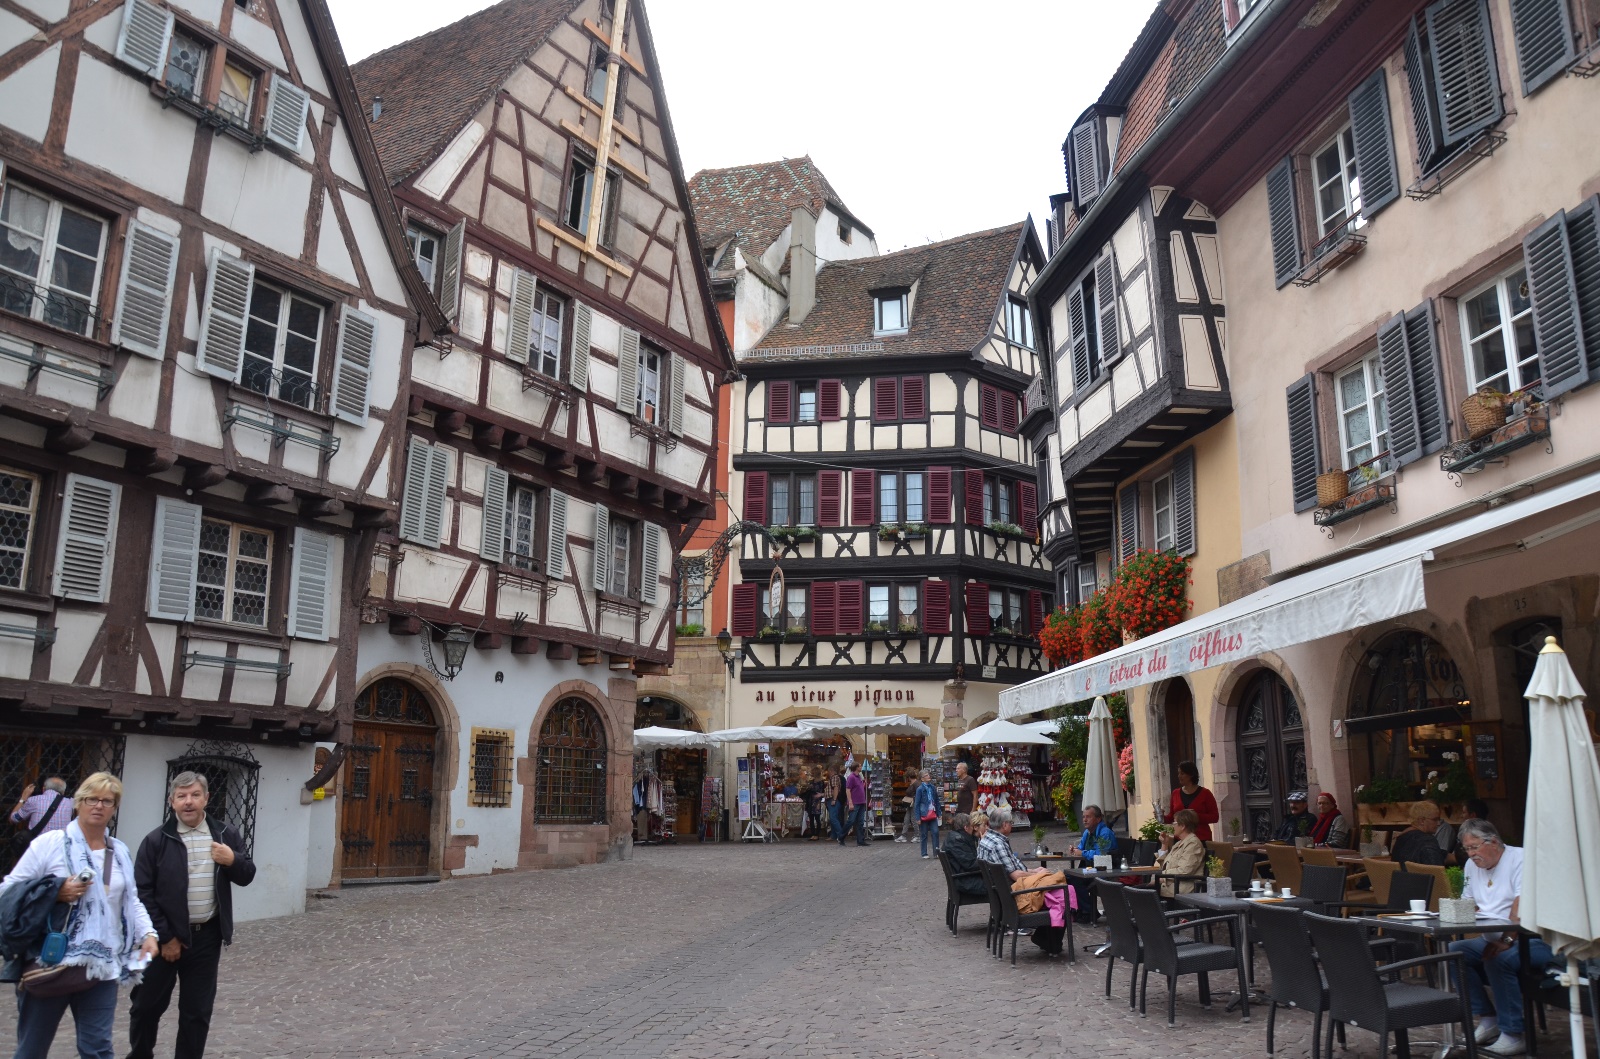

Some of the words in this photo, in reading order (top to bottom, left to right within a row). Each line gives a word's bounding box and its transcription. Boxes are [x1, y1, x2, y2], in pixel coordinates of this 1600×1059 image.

[1096, 657, 1143, 688] istrot
[1147, 649, 1167, 674] du
[1171, 629, 1243, 668] oïfhus
[755, 690, 775, 702] au
[790, 685, 836, 702] vieux
[853, 684, 915, 707] pignon
